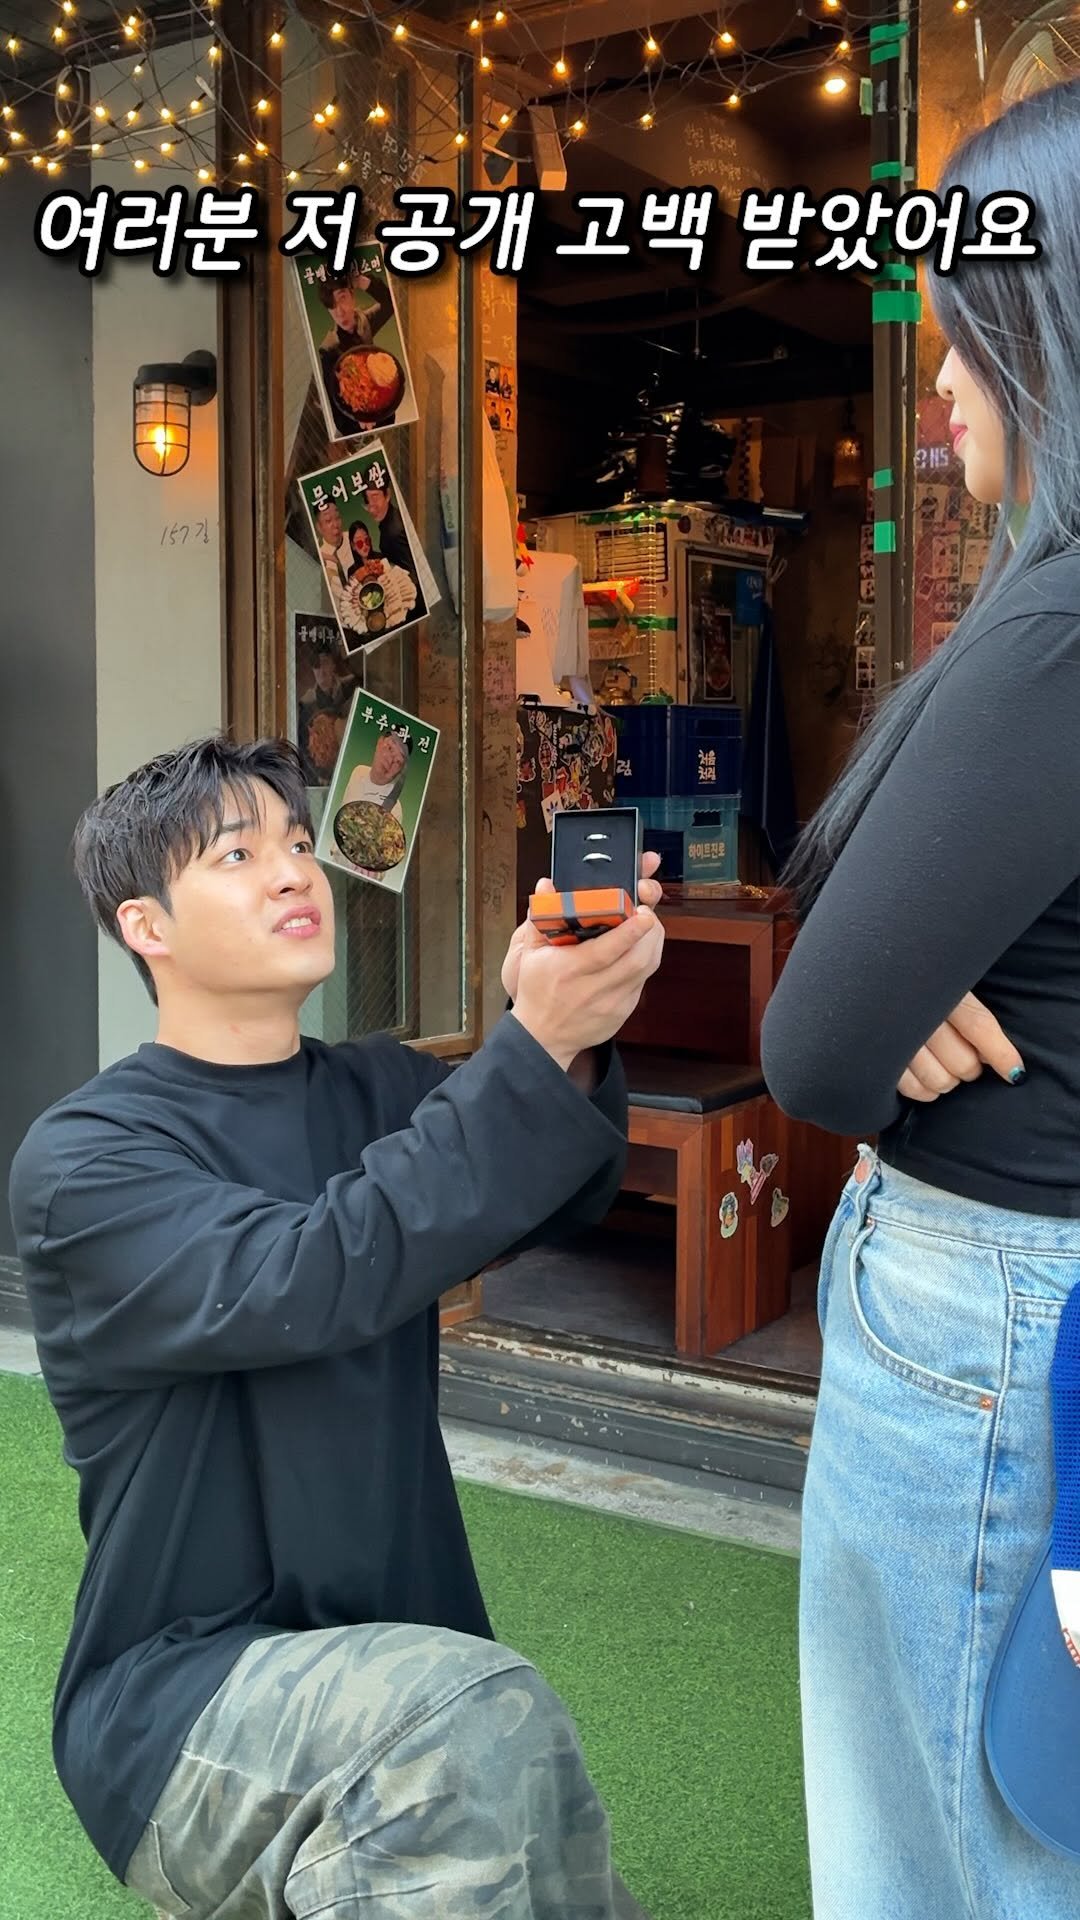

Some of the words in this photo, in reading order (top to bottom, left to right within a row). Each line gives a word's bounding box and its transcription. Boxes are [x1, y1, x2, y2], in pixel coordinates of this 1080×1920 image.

[312, 461, 386, 511] 문어보쌈
[160, 522, 190, 546] 157
[697, 749, 717, 766] 처음
[697, 765, 717, 781] 처럼
[688, 842, 726, 859] 하이트진로
